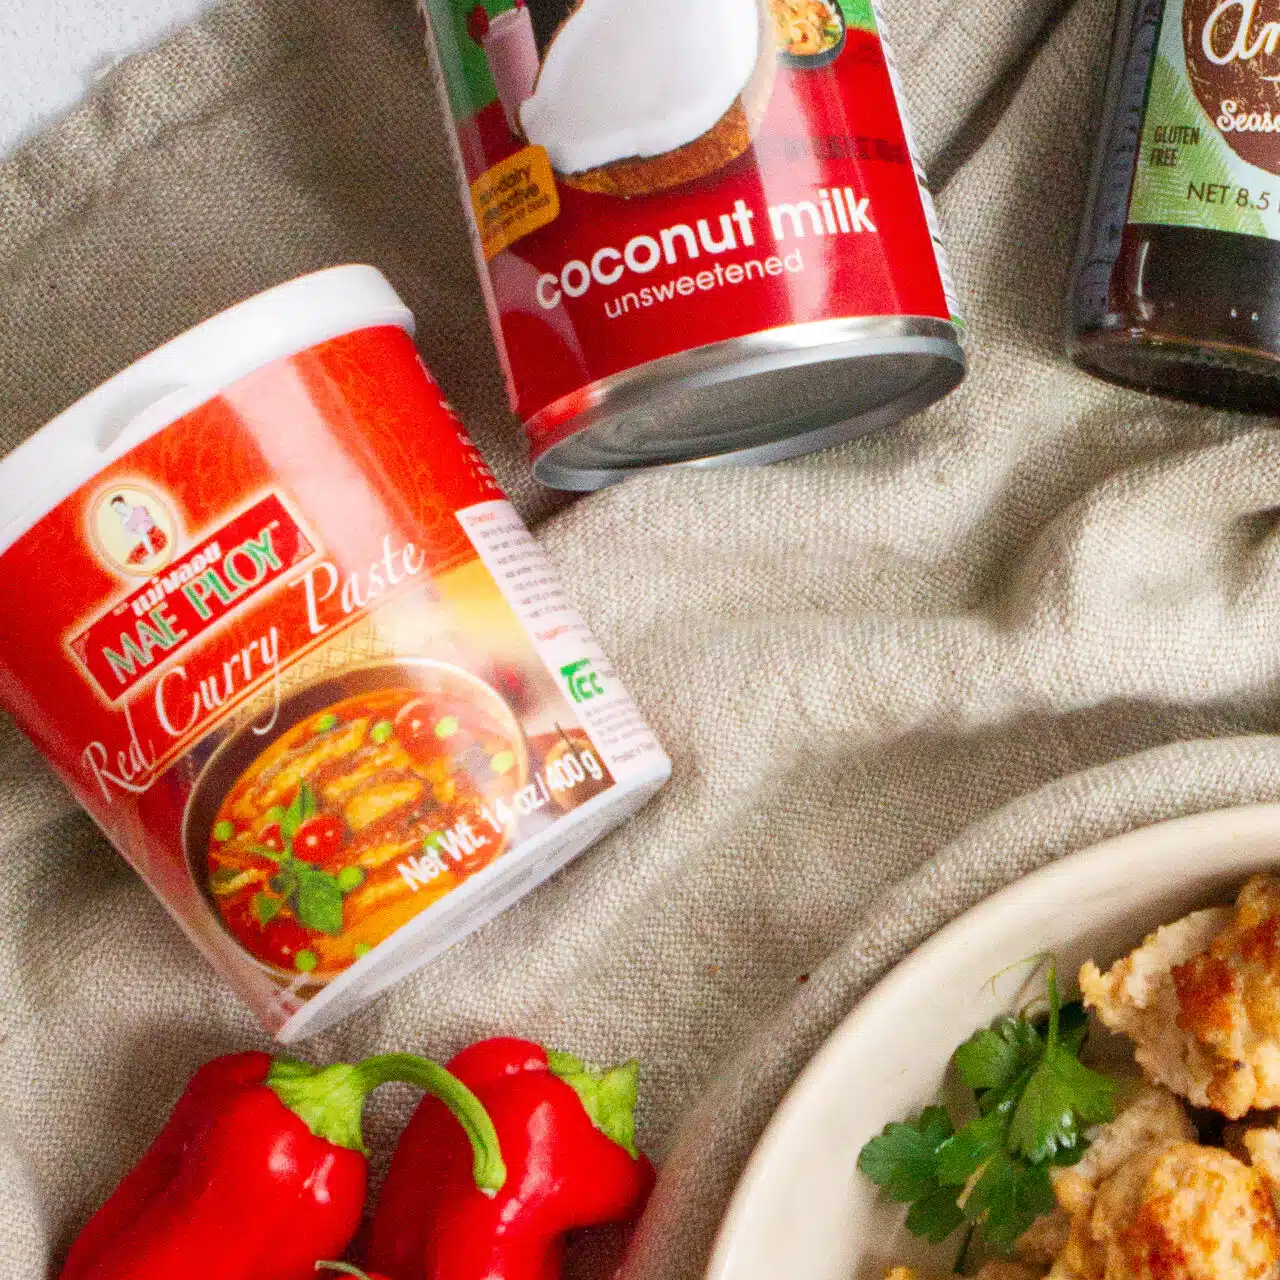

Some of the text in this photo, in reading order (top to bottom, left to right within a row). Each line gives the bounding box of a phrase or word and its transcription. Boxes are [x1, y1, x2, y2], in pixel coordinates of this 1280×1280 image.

[1150, 148, 1178, 167] FREE
[1153, 125, 1200, 145] GLUTEN
[1186, 181, 1230, 205] NET
[1236, 189, 1270, 211] 8.5
[536, 200, 755, 309] coconut
[768, 187, 877, 241] milk
[604, 249, 804, 319] unsweetened
[102, 528, 283, 684] MAE PLOY
[81, 697, 156, 803] Red
[155, 627, 281, 736] Curry
[288, 535, 425, 634] Paste
[397, 846, 449, 892] Net
